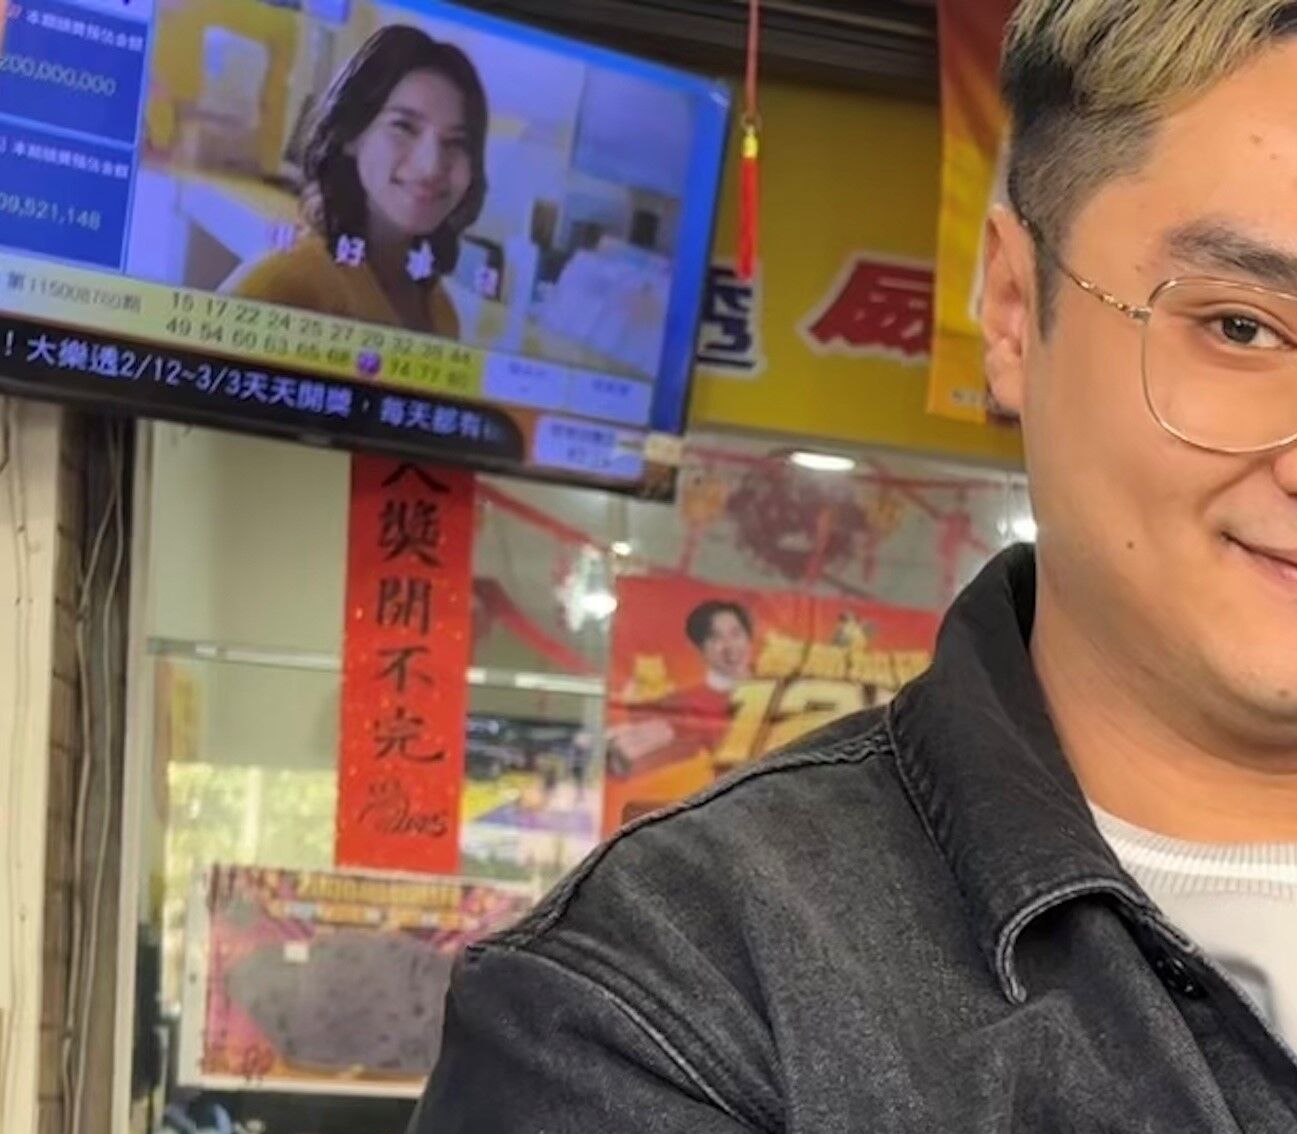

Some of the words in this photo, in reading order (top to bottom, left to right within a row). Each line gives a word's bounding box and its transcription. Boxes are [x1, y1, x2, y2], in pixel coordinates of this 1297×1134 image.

[26, 333, 490, 442] 大樂透2/12~3/3天天開獎，每天都有
